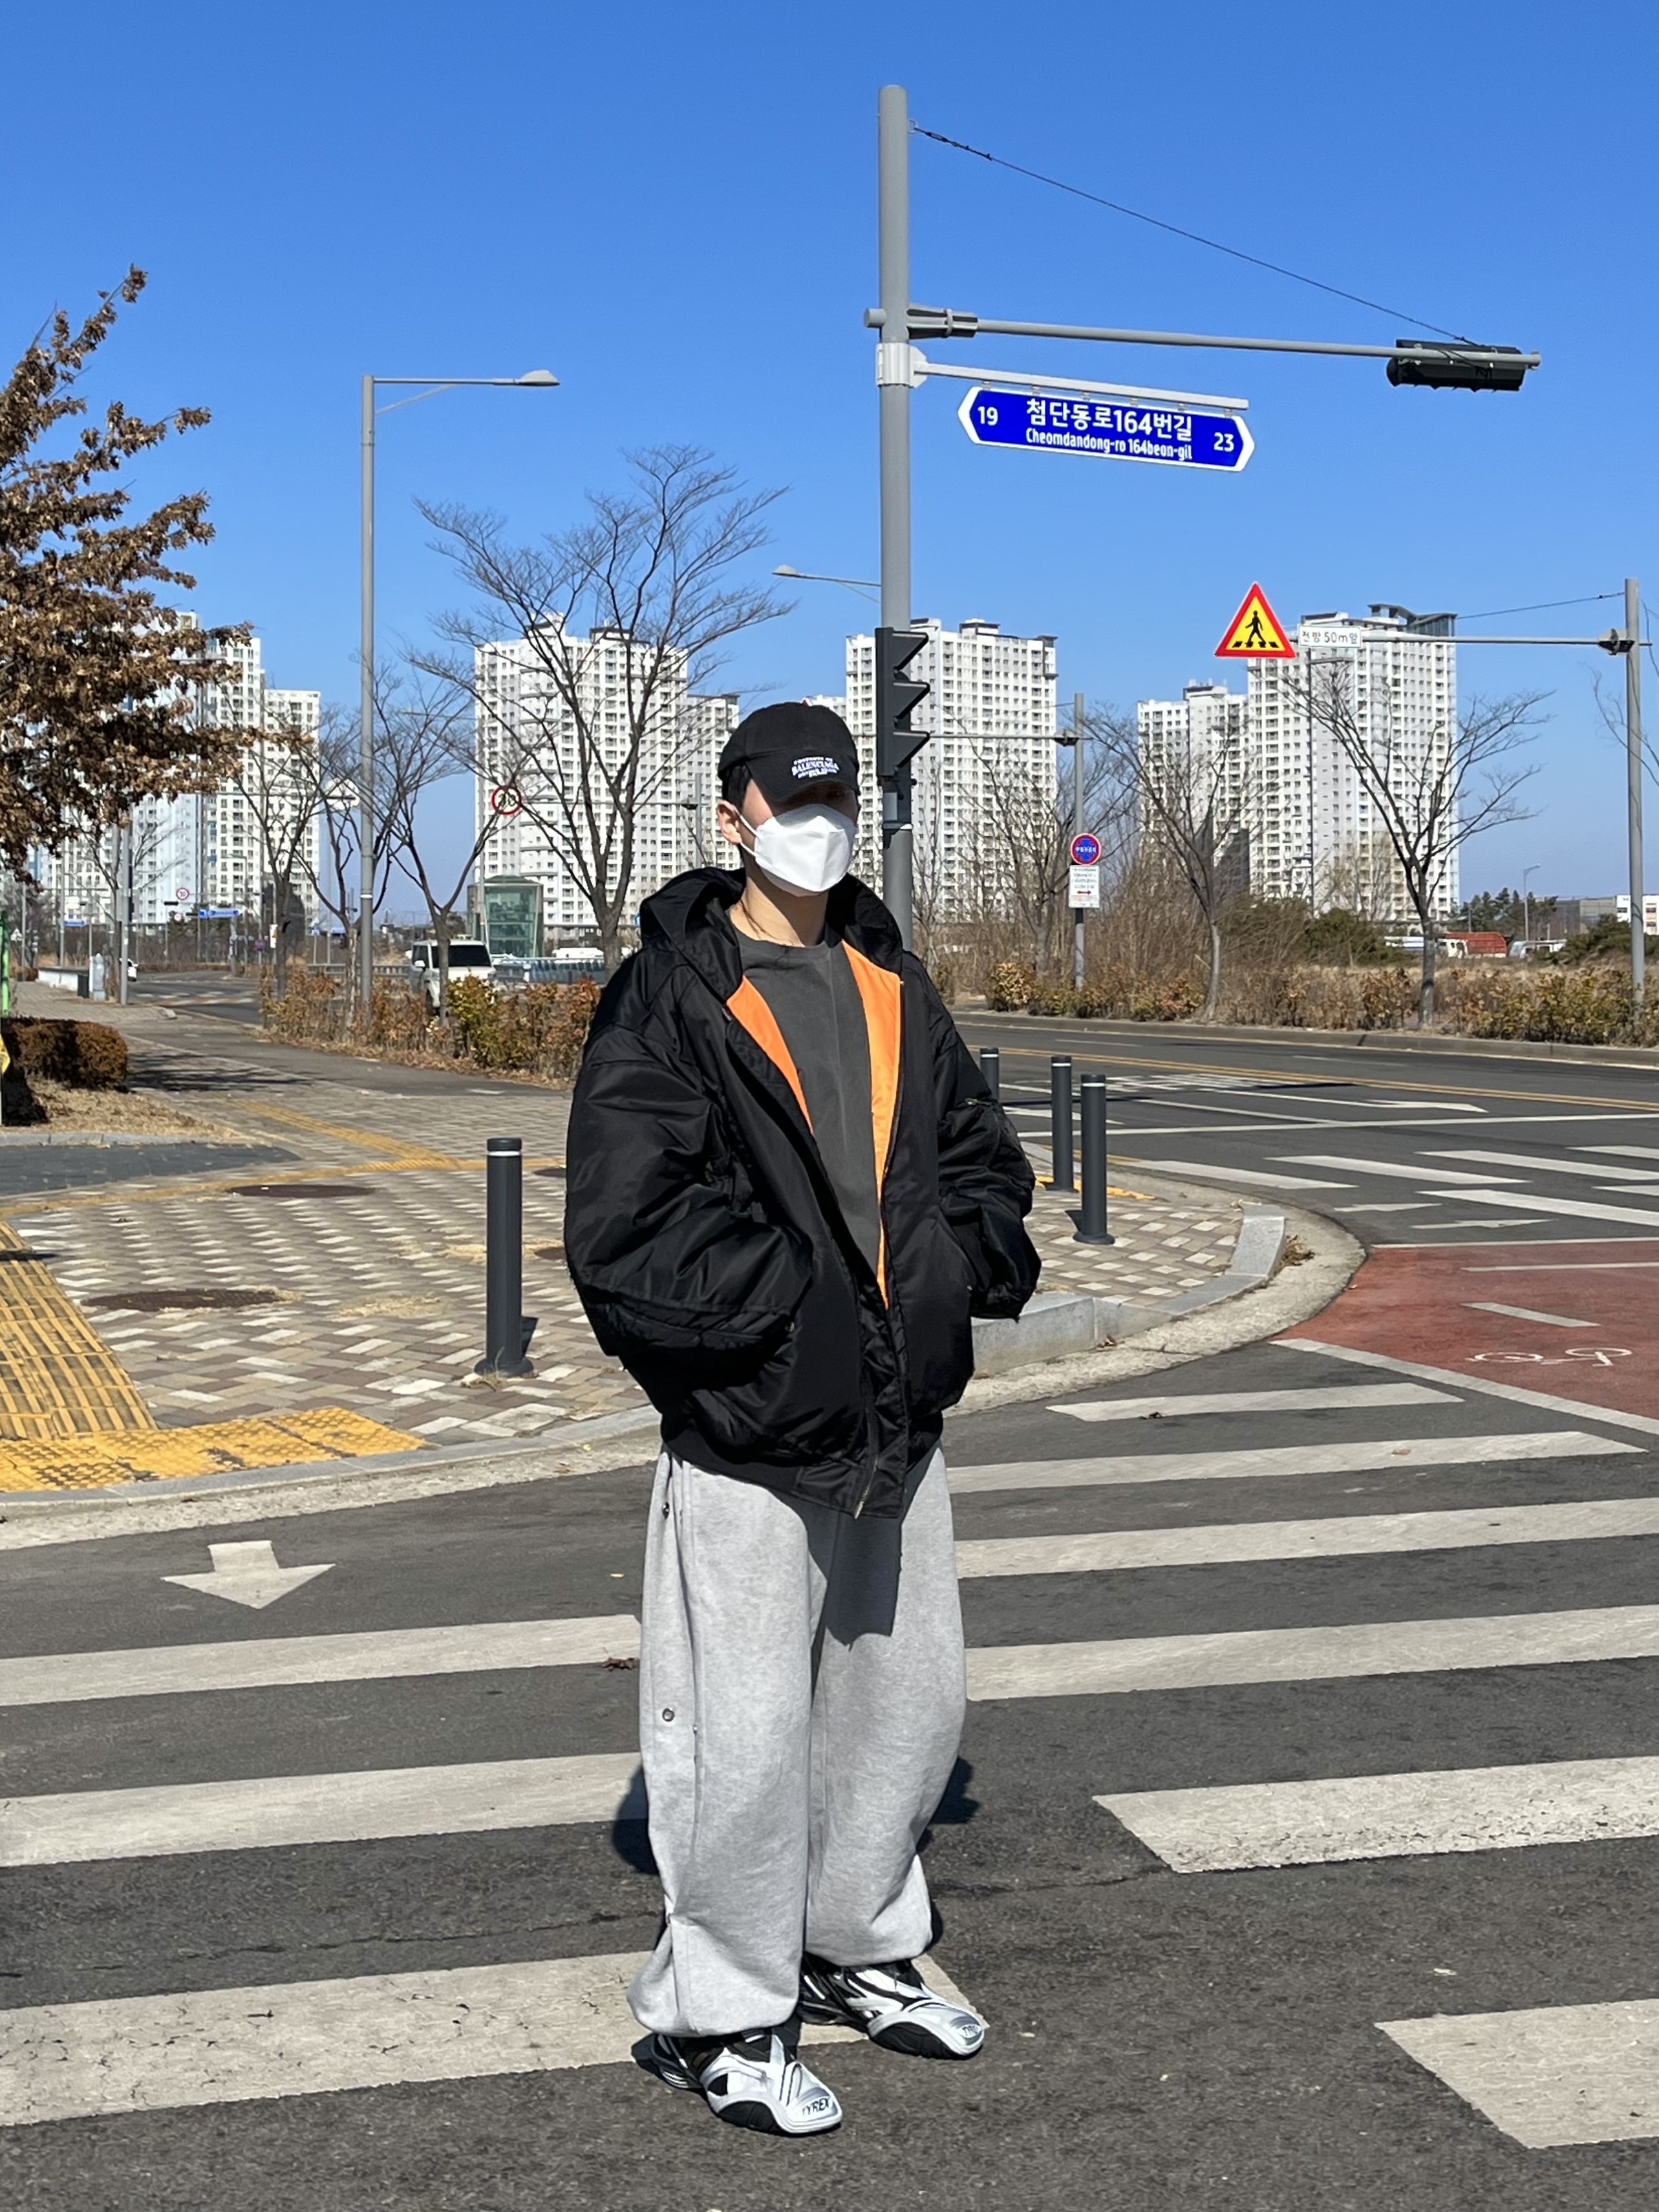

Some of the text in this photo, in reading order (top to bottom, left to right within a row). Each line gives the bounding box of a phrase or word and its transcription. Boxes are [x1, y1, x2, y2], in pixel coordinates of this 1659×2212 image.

[978, 406, 998, 426] 19
[1026, 398, 1192, 442] 첨단동로164번길
[1025, 427, 1193, 461] Cheomdandong-ro 164beon-gil
[1214, 432, 1235, 452] 23
